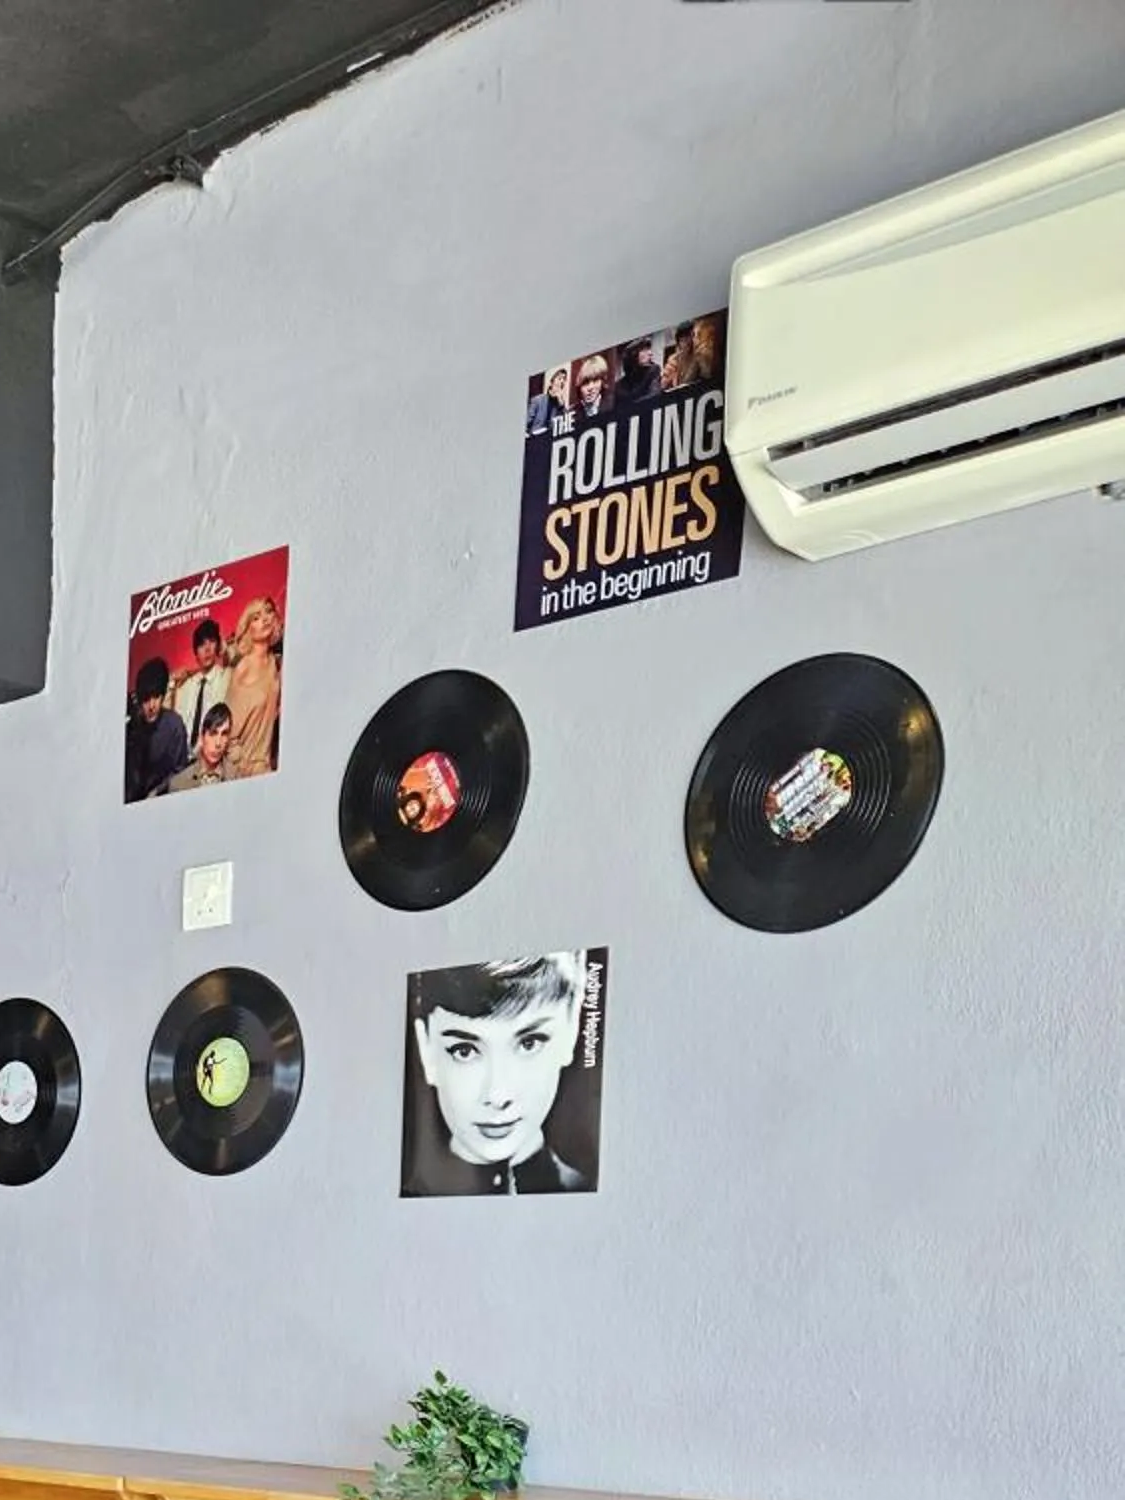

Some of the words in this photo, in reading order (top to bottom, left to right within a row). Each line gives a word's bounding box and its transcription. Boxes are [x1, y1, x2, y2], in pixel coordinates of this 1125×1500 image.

[548, 388, 724, 505] ROLLING
[552, 411, 576, 437] THE
[543, 465, 720, 581] STONES
[130, 570, 233, 639] Blondie
[540, 586, 559, 616] in
[562, 577, 597, 611] the
[600, 550, 712, 601] beginning
[583, 962, 604, 1009] Audrey
[582, 1011, 602, 1069] Hepburn
